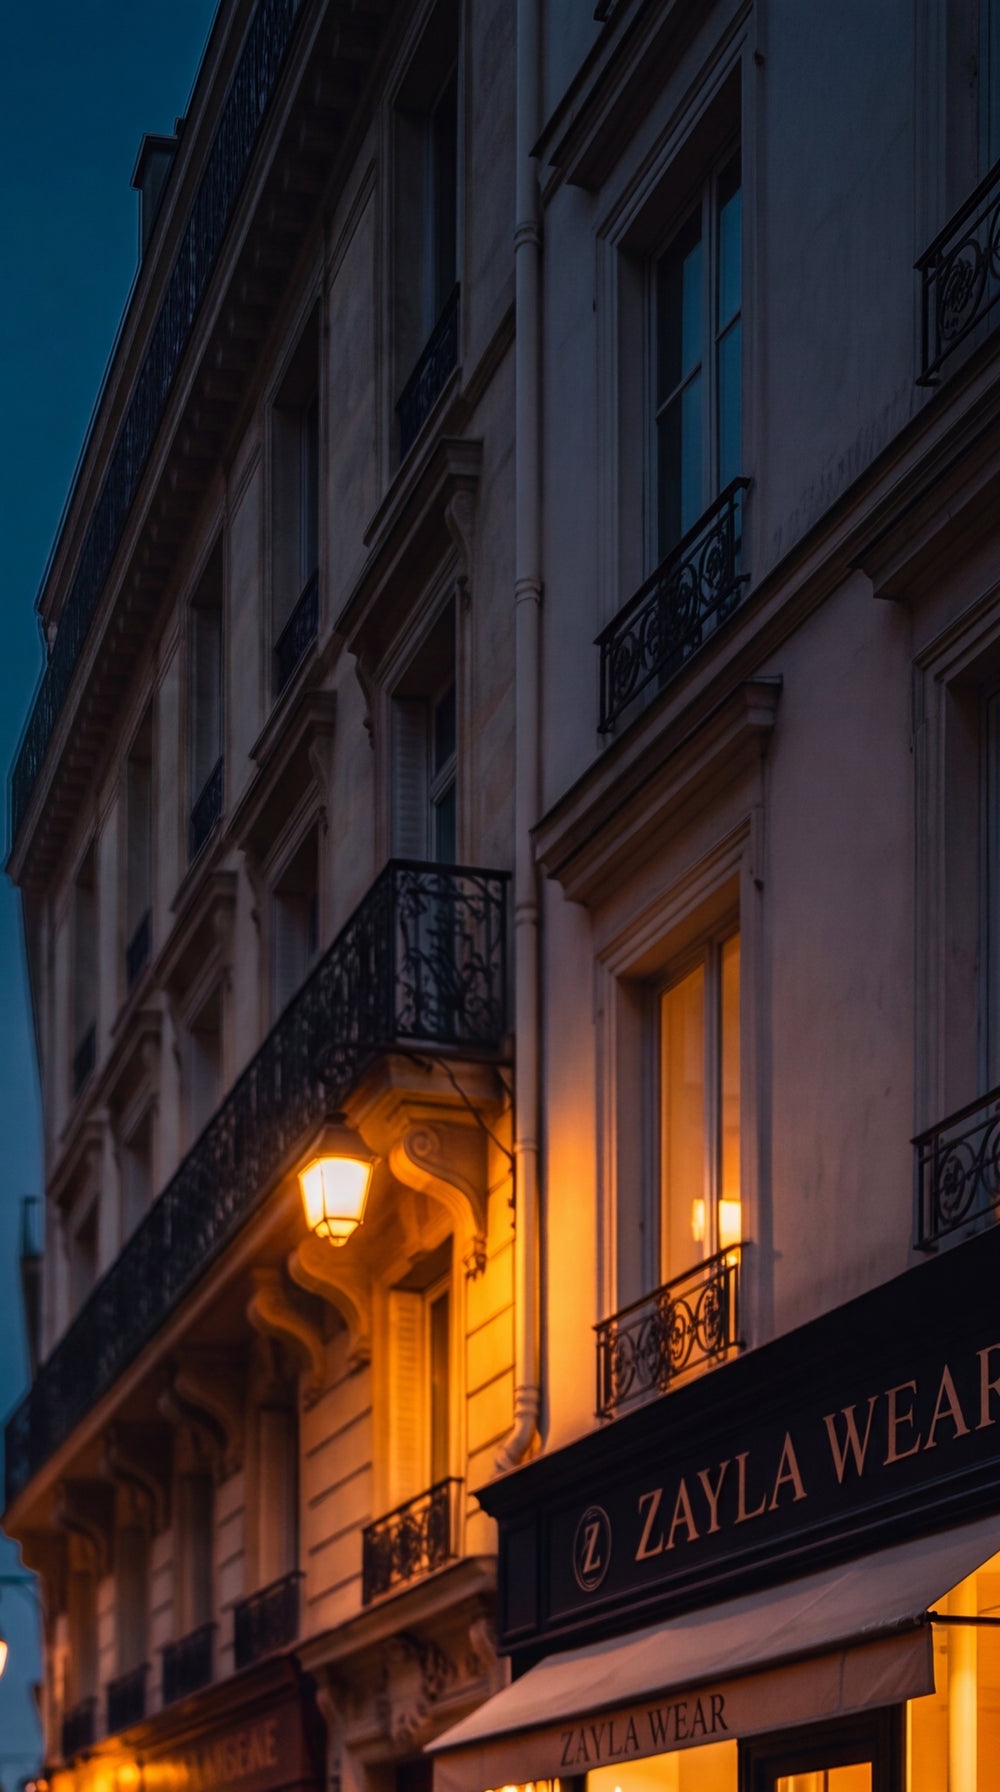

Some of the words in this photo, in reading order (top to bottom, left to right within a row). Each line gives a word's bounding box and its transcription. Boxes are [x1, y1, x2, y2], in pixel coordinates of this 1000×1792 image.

[635, 1431, 808, 1561] ZAYLA
[583, 1522, 601, 1574] Z
[560, 1715, 640, 1767] ZAYLA
[648, 1693, 728, 1746] WEAR
